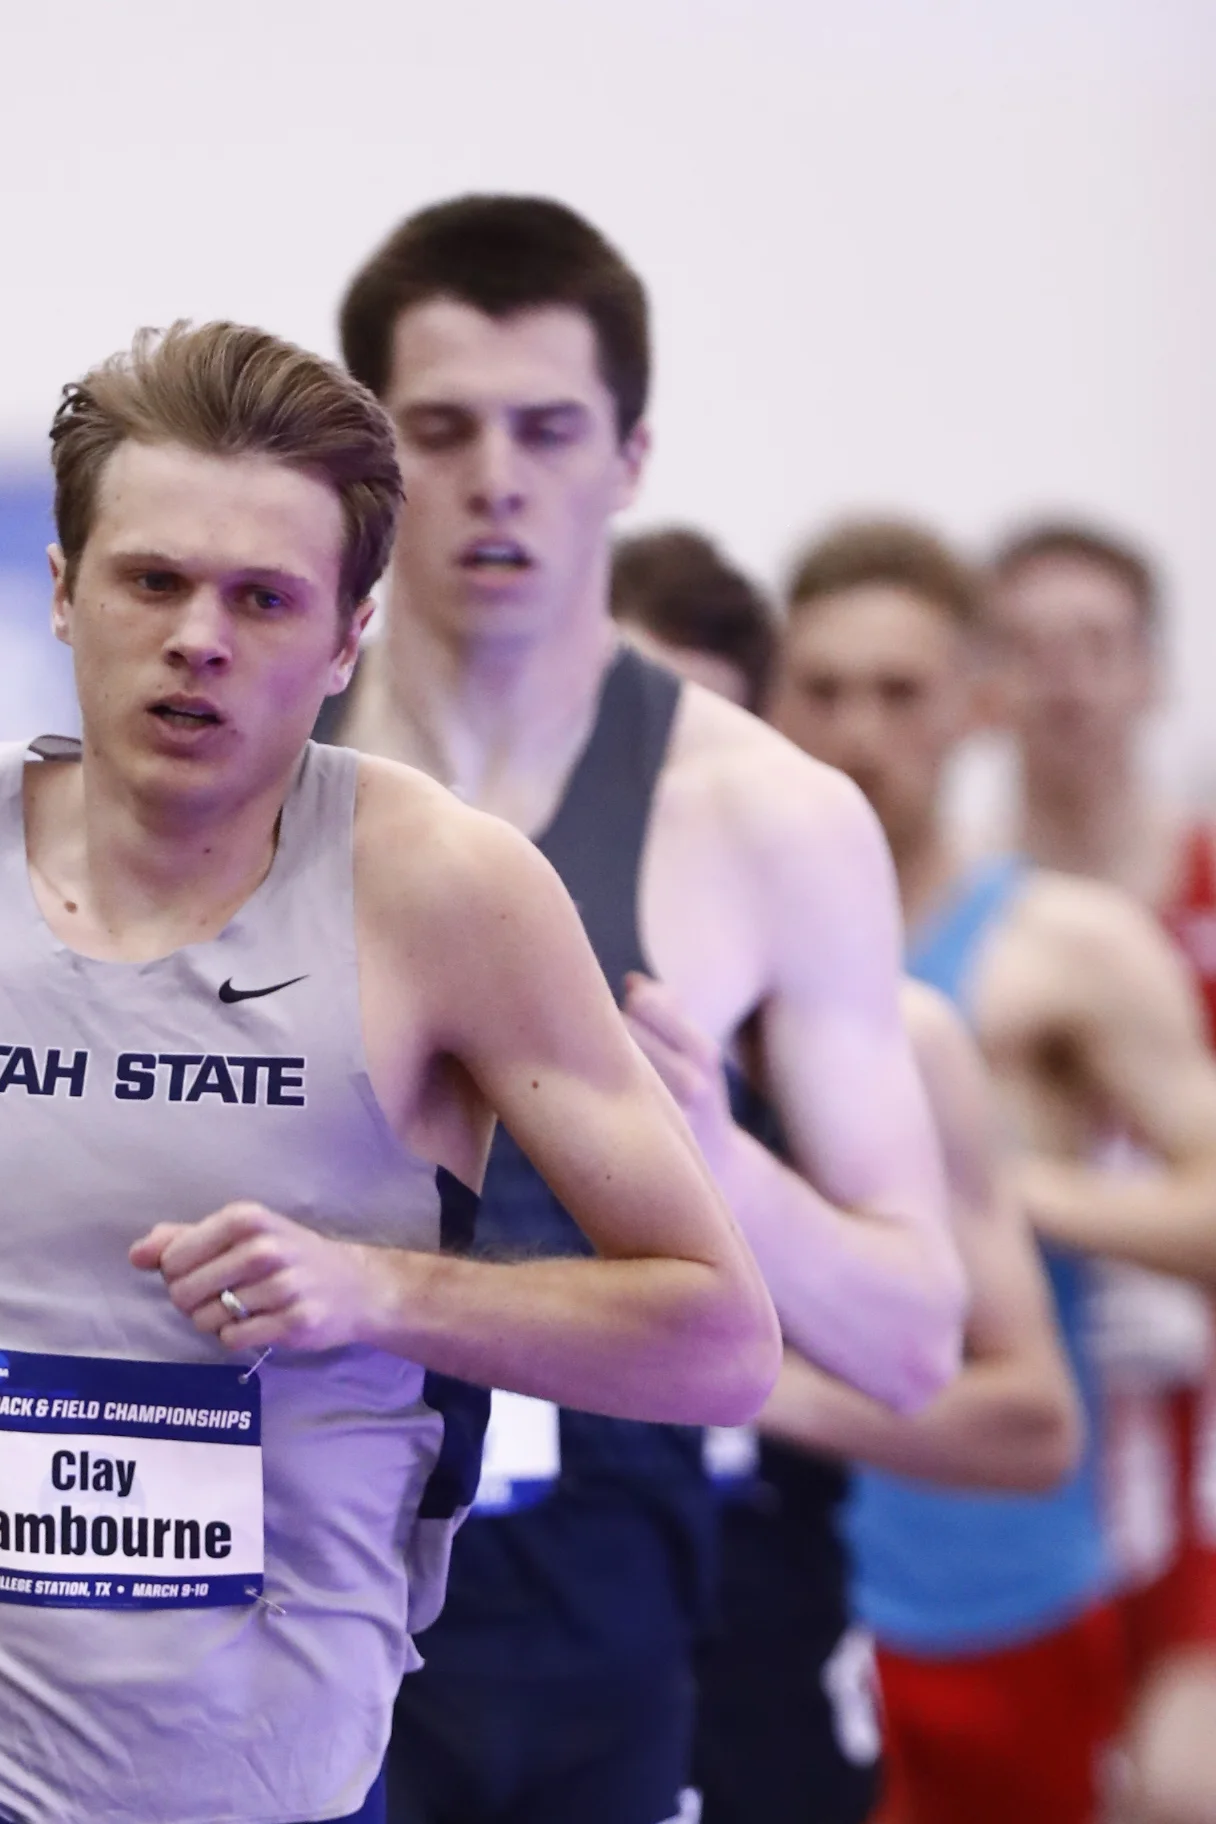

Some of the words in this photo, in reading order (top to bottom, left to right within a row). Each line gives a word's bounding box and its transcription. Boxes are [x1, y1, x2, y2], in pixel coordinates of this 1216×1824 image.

[113, 1052, 307, 1107] STATE
[36, 1397, 49, 1418] &
[51, 1398, 99, 1420] FIELD
[103, 1402, 251, 1430] CHAMPIONSHIPS
[51, 1450, 137, 1497] Clay
[34, 1579, 90, 1597] STATION,
[94, 1582, 112, 1597] TX
[131, 1583, 178, 1598] MARCH
[180, 1583, 209, 1597] 9-10
